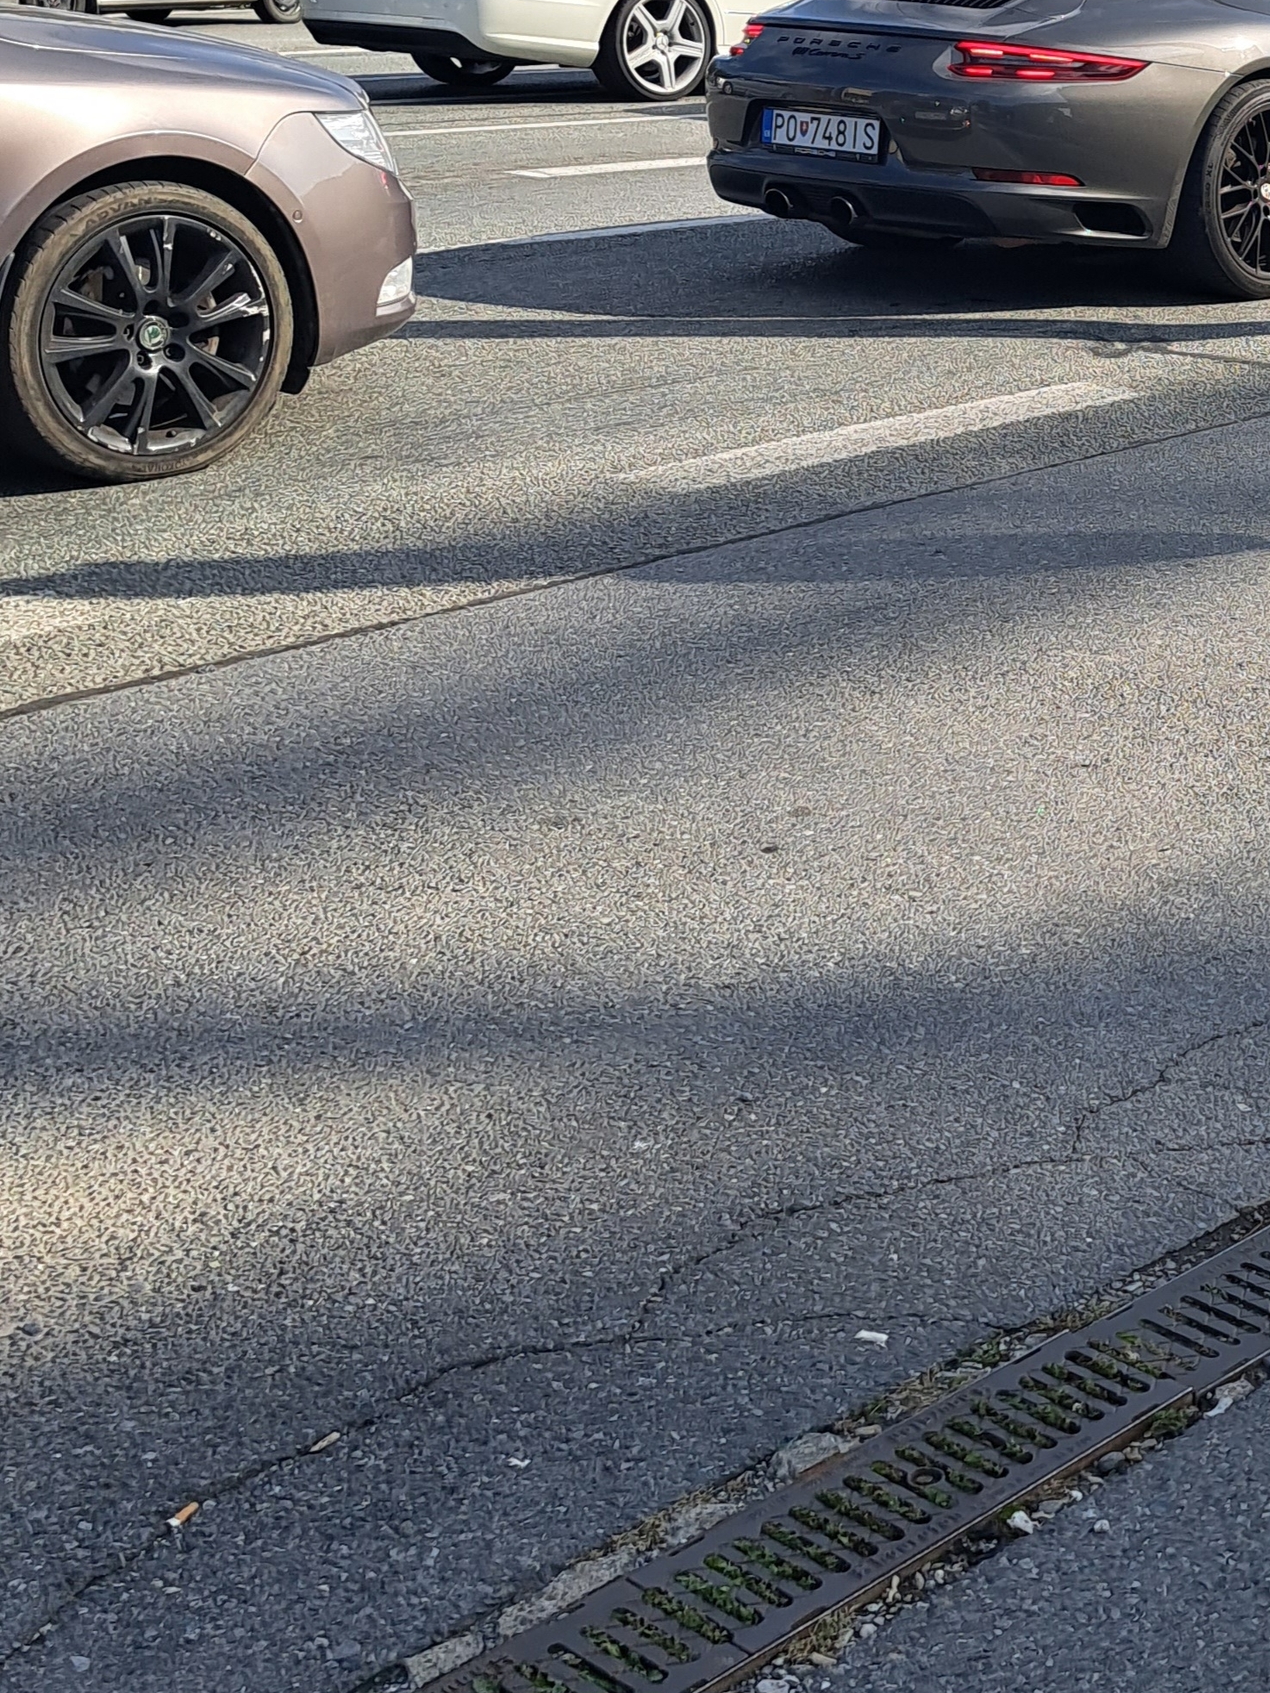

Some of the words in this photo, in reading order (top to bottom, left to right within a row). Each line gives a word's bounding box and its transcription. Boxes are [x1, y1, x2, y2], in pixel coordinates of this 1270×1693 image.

[777, 36, 902, 53] PORSCHE
[773, 112, 797, 142] PO
[809, 116, 876, 151] 748IS
[85, 196, 151, 227] ADVAN
